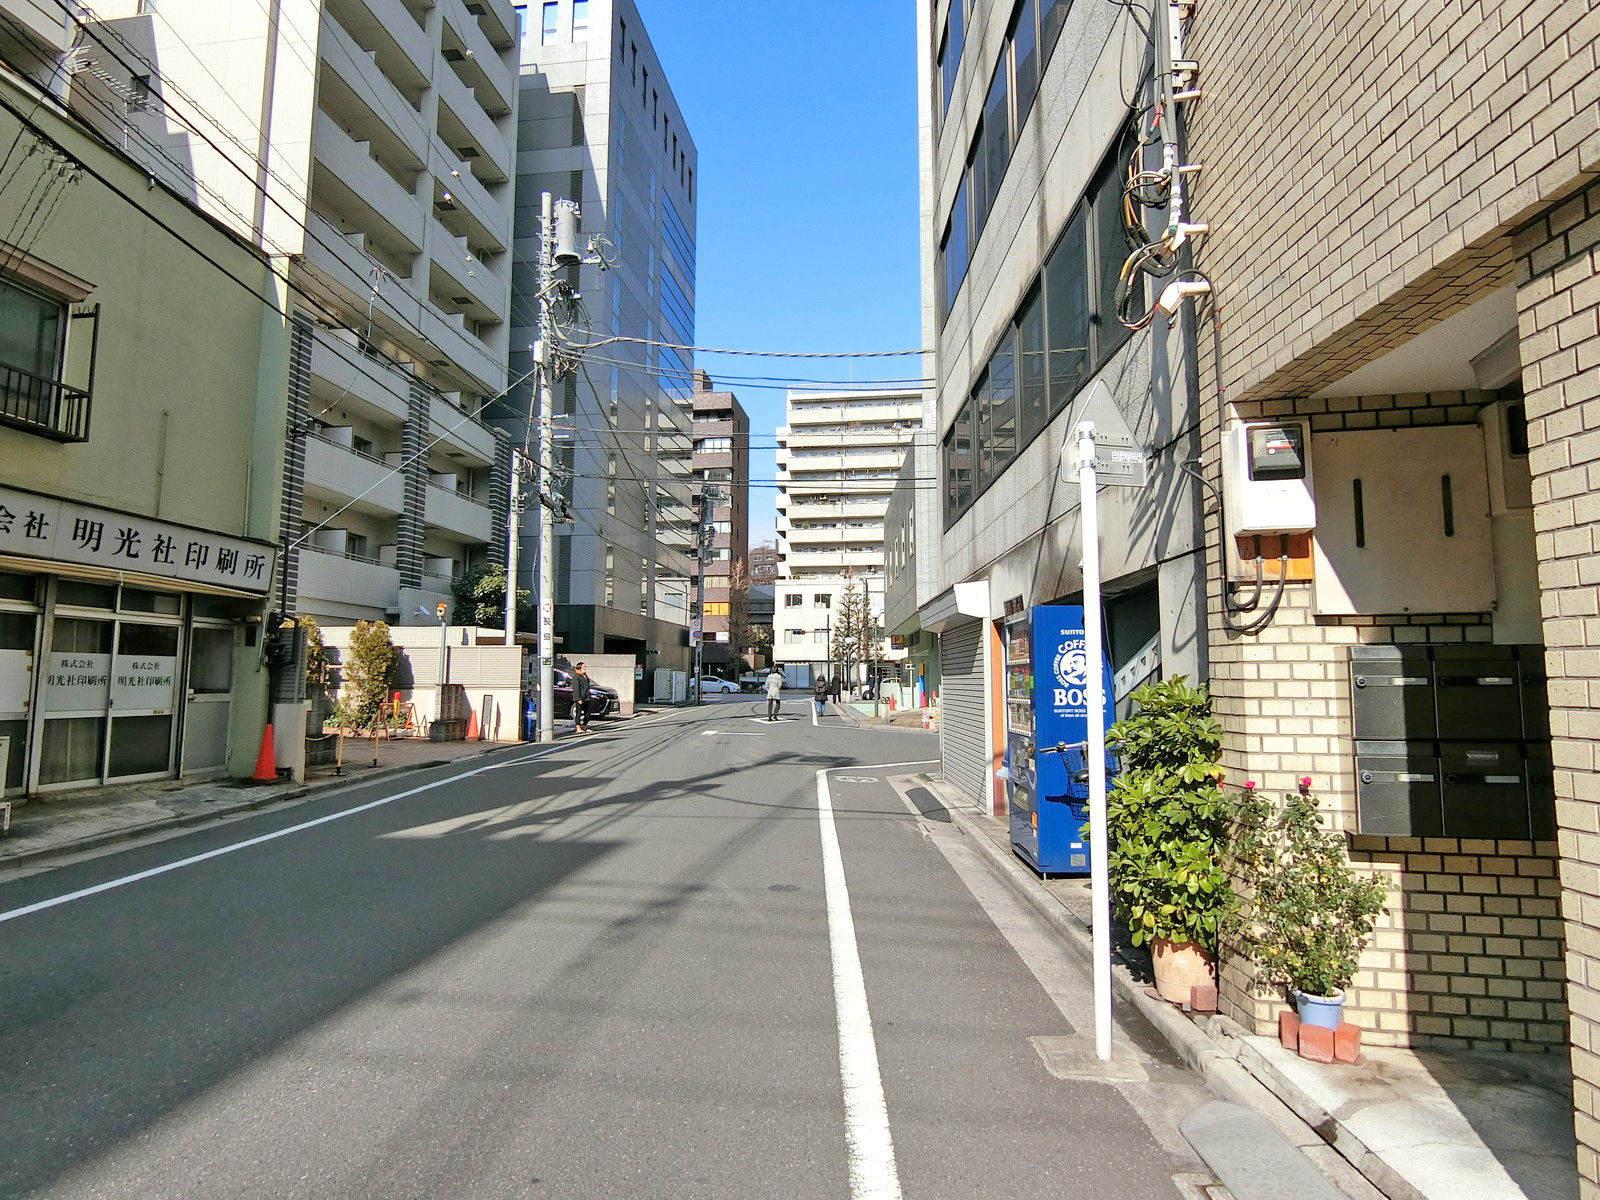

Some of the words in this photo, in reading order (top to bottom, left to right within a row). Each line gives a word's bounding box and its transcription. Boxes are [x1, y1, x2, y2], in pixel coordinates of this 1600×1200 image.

[72, 517, 266, 580] 明光社印刷所
[1058, 639, 1086, 654] COFF
[61, 659, 95, 669] 株式会社
[132, 661, 161, 670] 株式会社
[117, 676, 172, 687] 明光社印刷所
